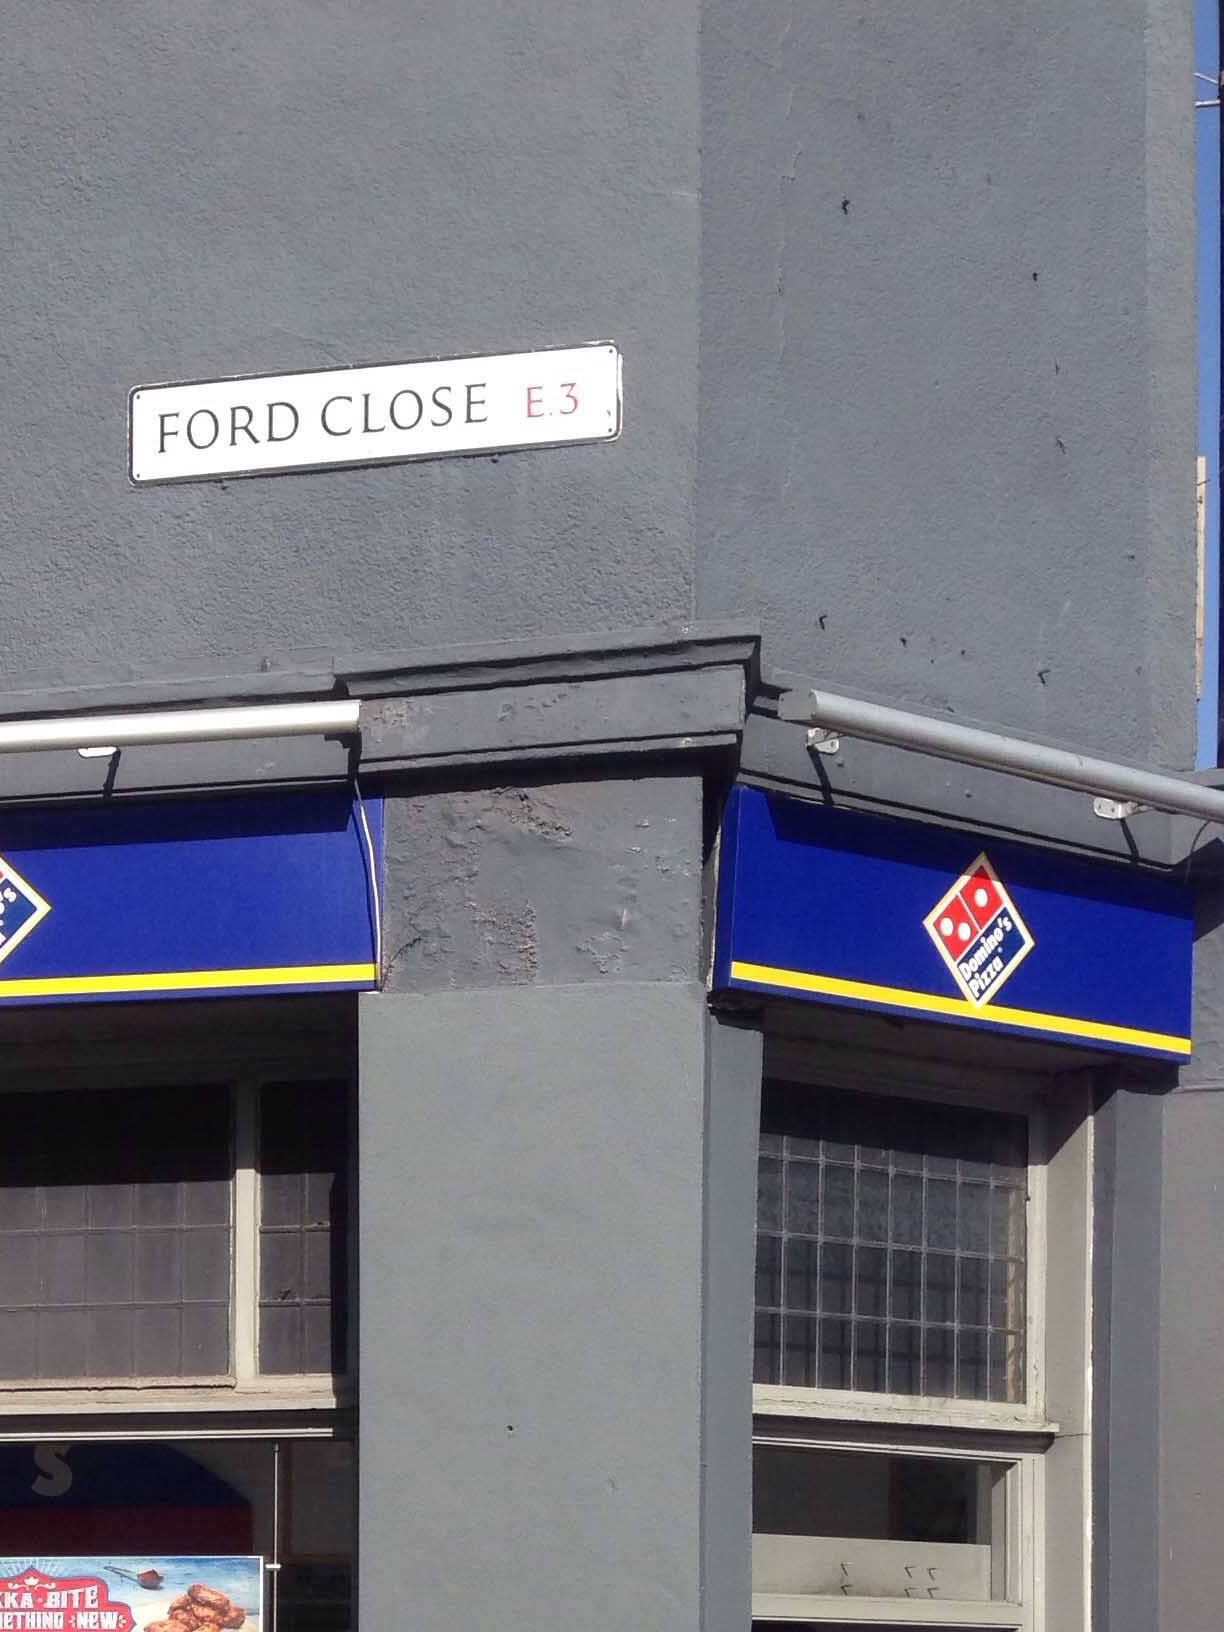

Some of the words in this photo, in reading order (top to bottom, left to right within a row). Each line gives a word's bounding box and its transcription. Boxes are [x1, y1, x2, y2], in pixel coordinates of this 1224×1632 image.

[157, 401, 300, 454] FORD
[320, 382, 488, 437] CLOSE
[957, 915, 1013, 982] Domino's
[968, 955, 1004, 999] Pizza
[44, 1584, 99, 1609] BITE
[76, 1611, 119, 1630] NEW
